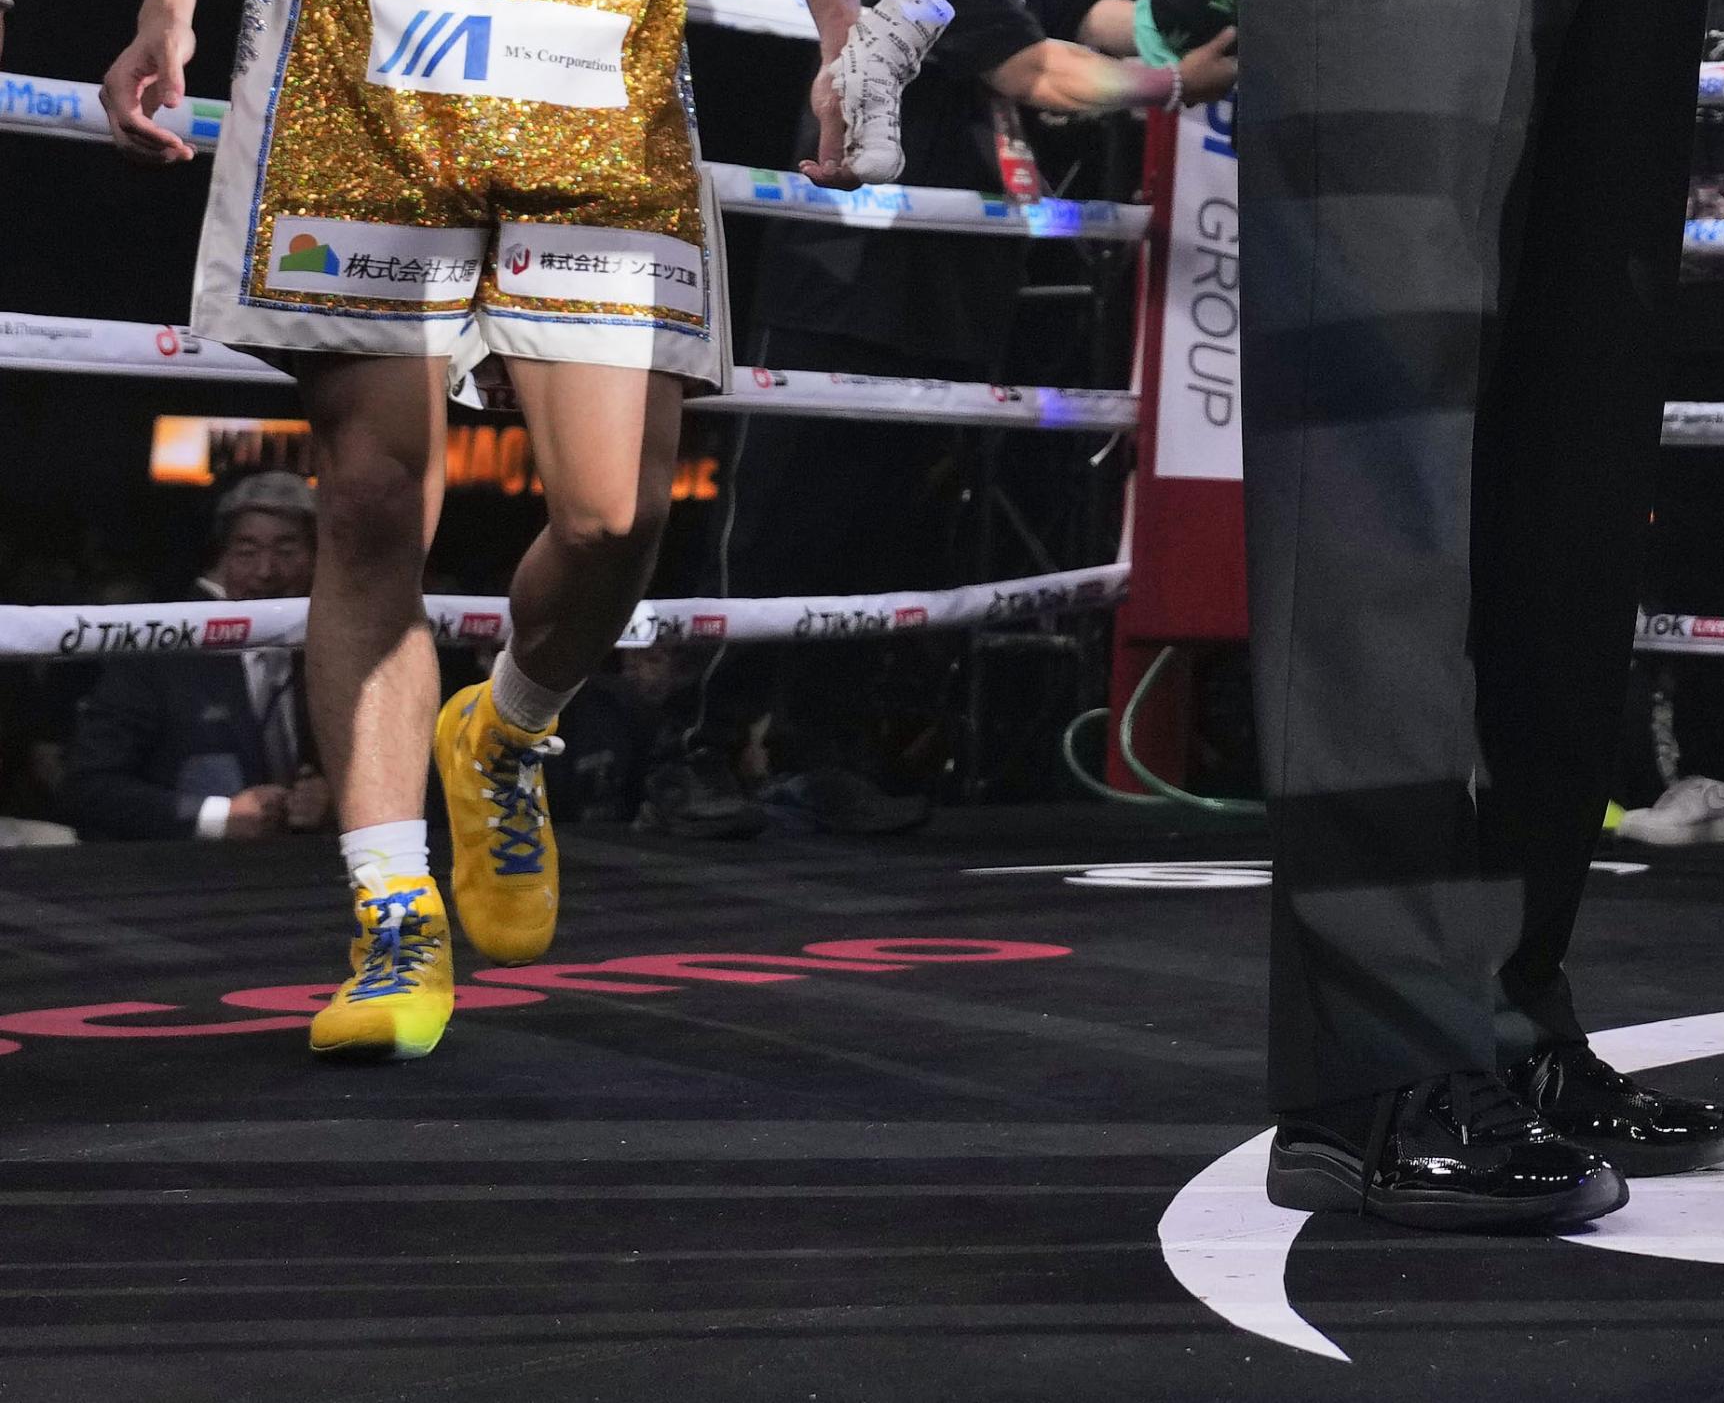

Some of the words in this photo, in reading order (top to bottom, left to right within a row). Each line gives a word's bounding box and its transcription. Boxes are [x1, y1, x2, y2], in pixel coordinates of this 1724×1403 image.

[504, 44, 534, 61] M's
[537, 47, 619, 74] Corporation
[0, 79, 83, 120] Mart
[1187, 196, 1240, 429] GROUP
[97, 617, 201, 651] TikTok
[206, 621, 248, 644] LIVE
[0, 934, 1074, 1056] como
